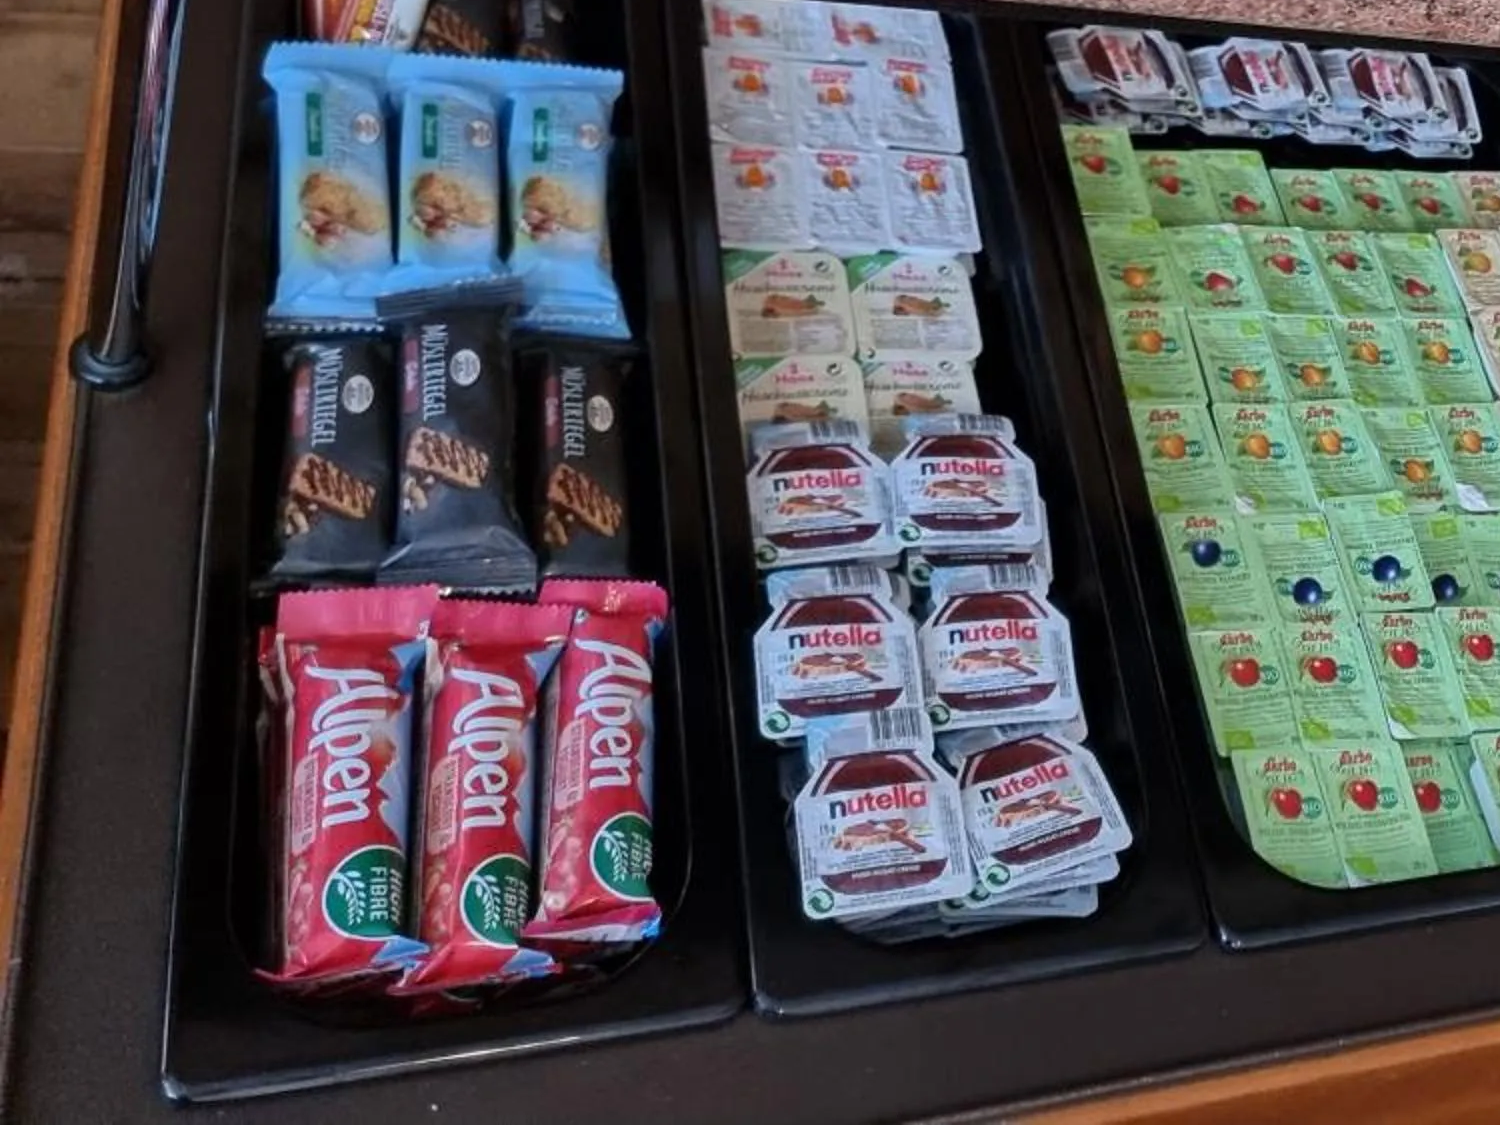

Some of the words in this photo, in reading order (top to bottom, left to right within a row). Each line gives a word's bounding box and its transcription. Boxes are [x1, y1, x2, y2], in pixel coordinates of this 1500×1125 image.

[774, 472, 862, 493] nutella
[921, 461, 1004, 477] nutella
[789, 624, 882, 649] nutella
[949, 621, 1038, 645] nutella
[576, 640, 652, 789] Alpen
[305, 666, 400, 828] Alpen
[451, 668, 526, 829] Alpen
[830, 785, 927, 819] nutella
[981, 761, 1070, 803] nutella
[369, 866, 388, 921] FIBRE
[504, 876, 519, 928] FIBRE
